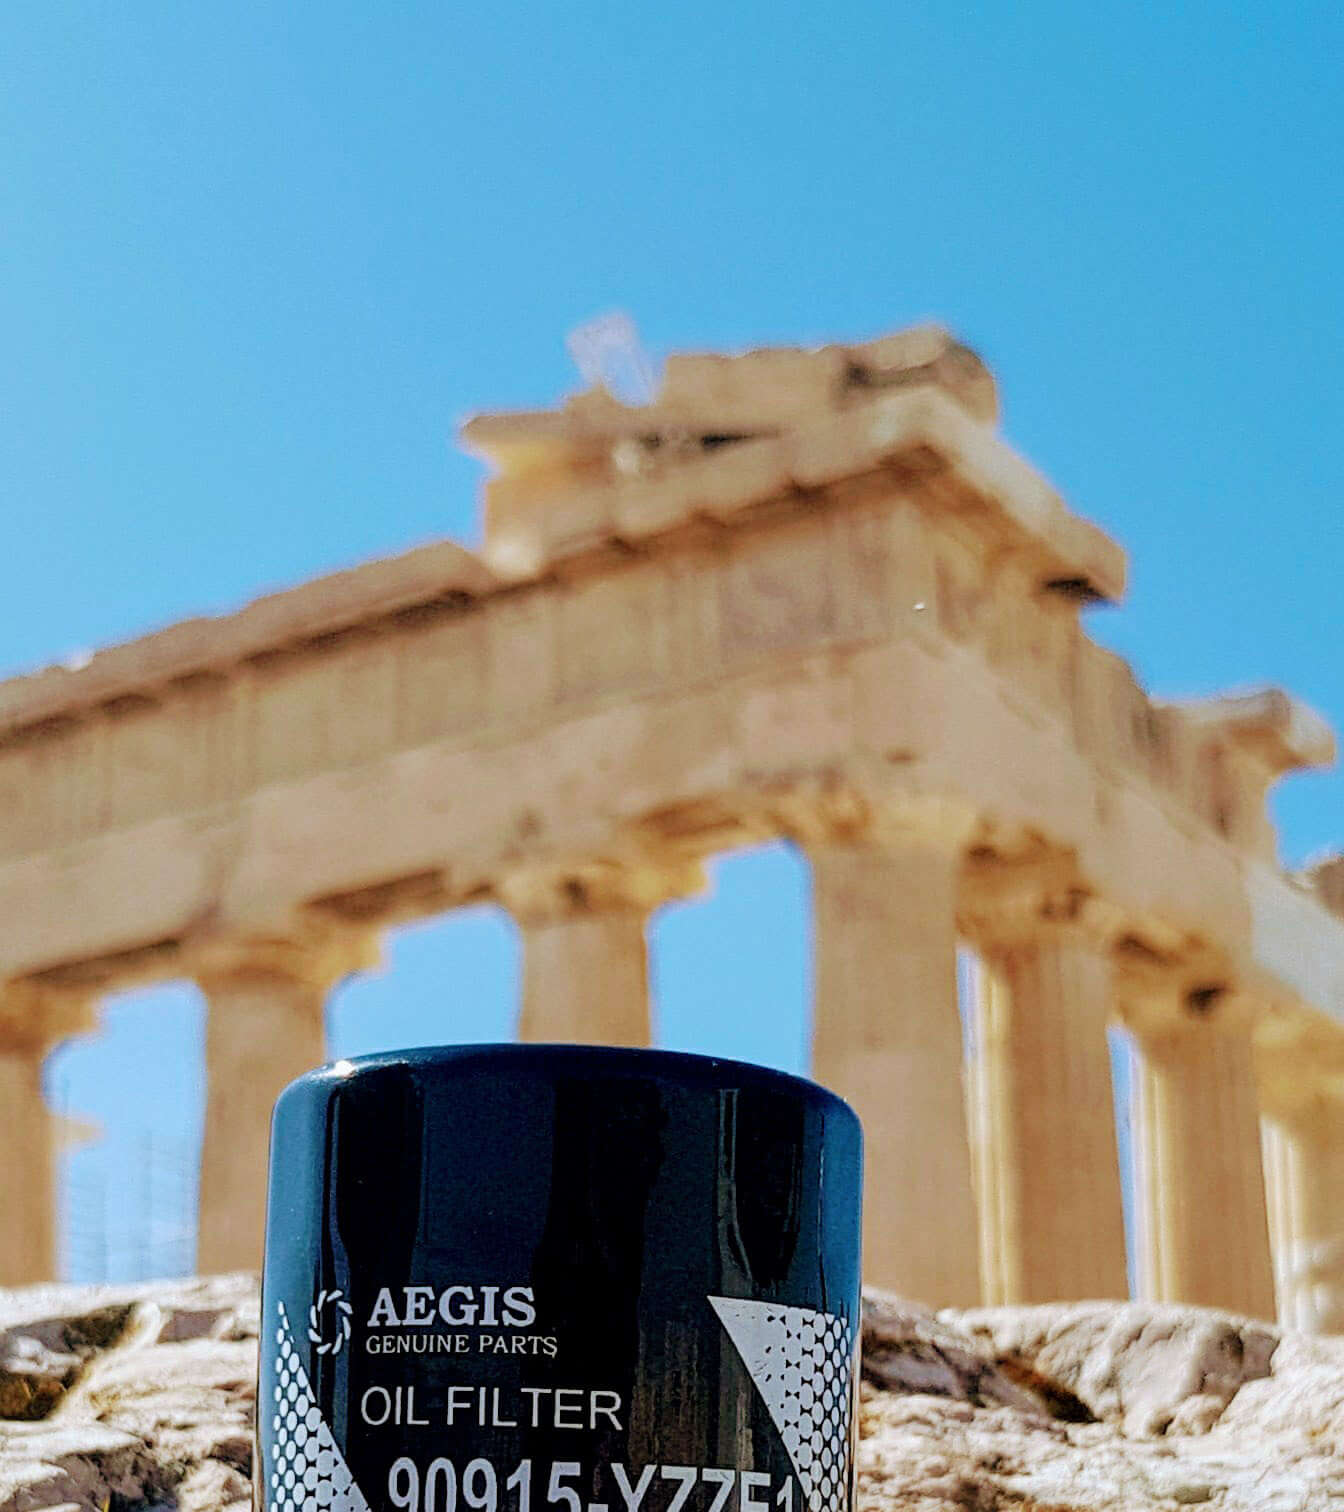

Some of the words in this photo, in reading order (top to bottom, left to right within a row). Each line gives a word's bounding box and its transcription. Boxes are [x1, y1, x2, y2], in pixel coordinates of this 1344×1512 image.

[367, 1286, 536, 1327] AEGIS
[366, 1335, 470, 1354] GENUINE
[479, 1336, 558, 1359] PARTS
[361, 1386, 430, 1426] OIL
[447, 1386, 623, 1431] FILTER
